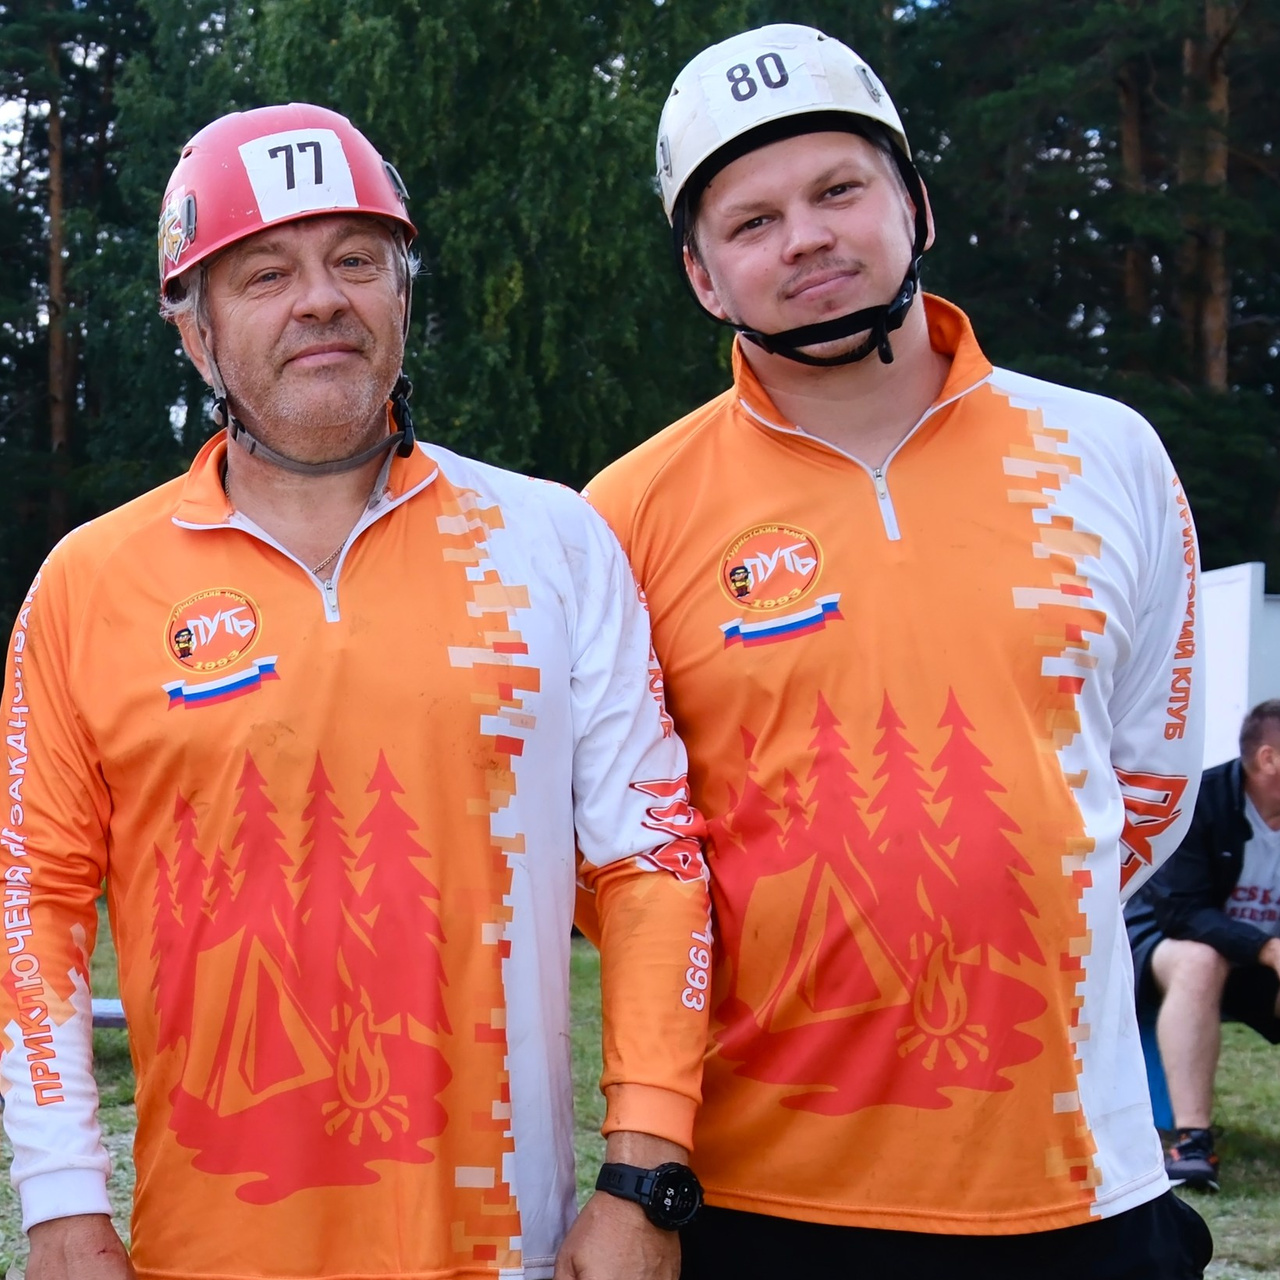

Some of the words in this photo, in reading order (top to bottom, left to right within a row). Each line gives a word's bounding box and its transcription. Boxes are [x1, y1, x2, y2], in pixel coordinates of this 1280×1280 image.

[726, 52, 789, 102] 80
[268, 141, 323, 190] 77
[743, 542, 817, 590] ПУТЬ
[751, 588, 802, 608] 1993
[186, 606, 256, 651] ПУТЬ
[194, 650, 240, 670] 1993
[1163, 667, 1192, 740] КЛУБ
[681, 930, 710, 1012] 1993
